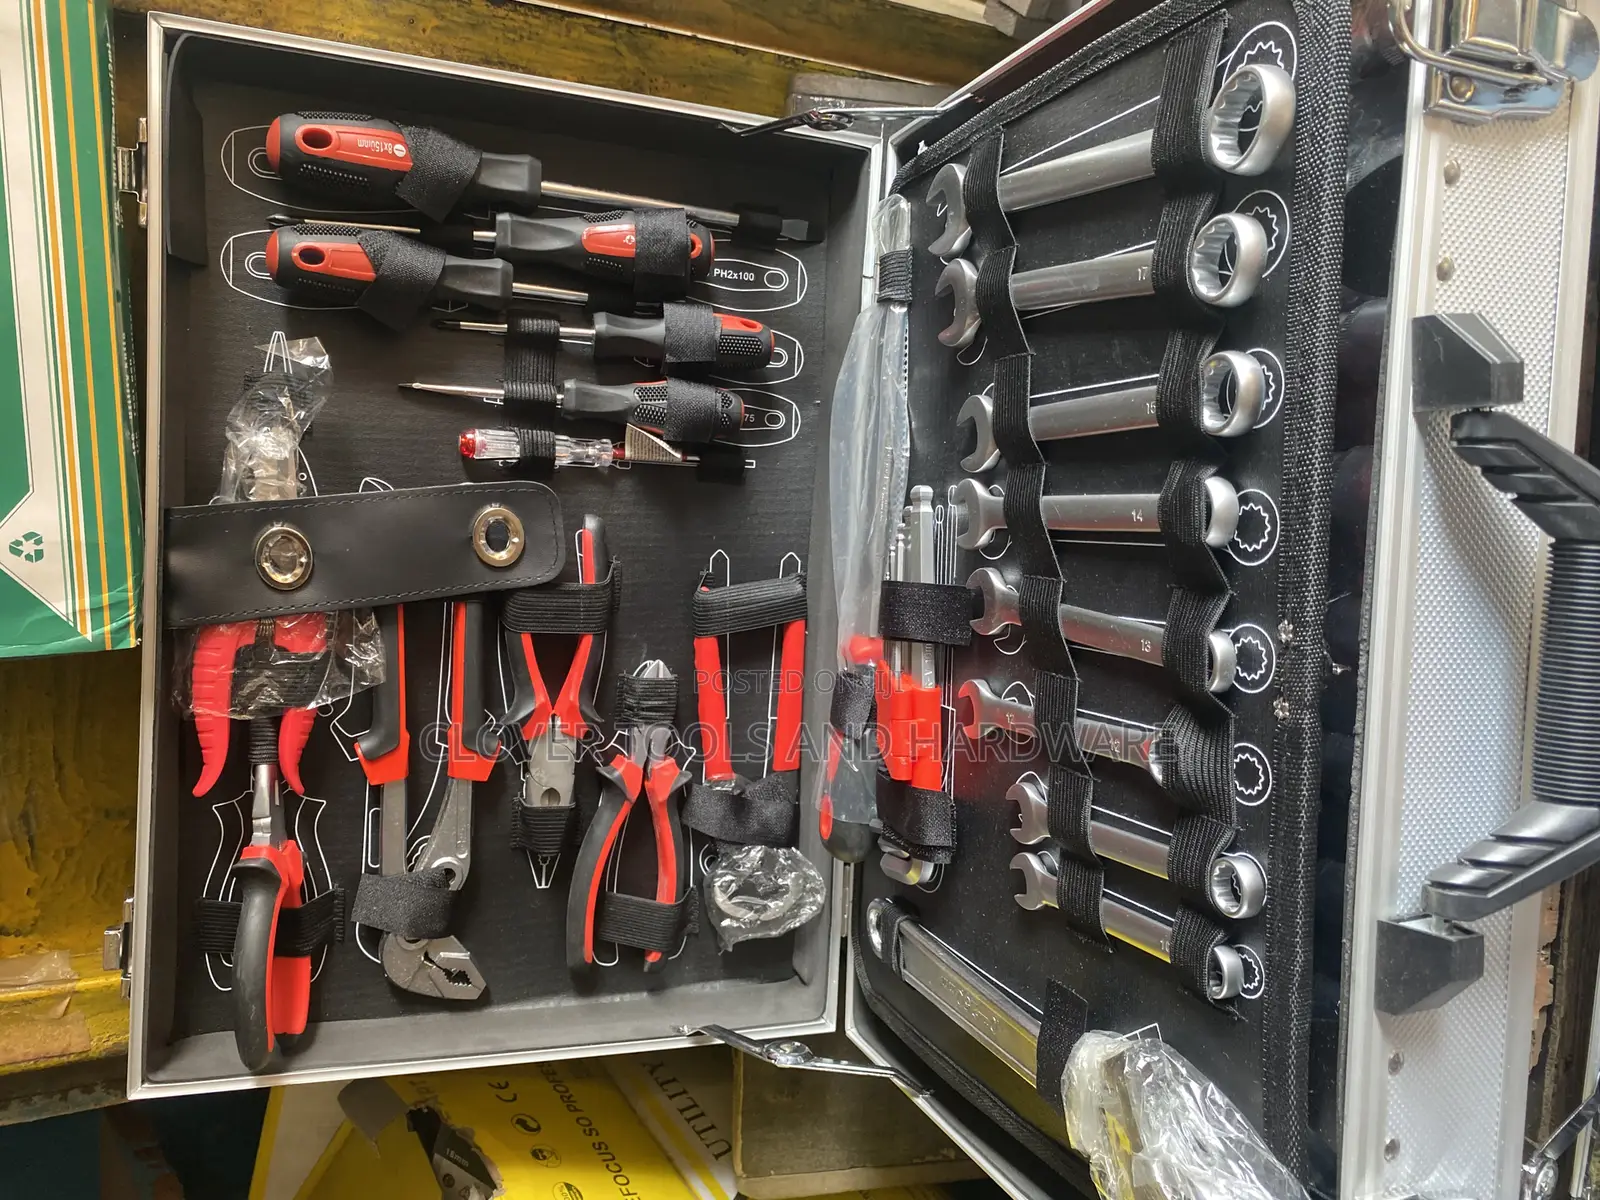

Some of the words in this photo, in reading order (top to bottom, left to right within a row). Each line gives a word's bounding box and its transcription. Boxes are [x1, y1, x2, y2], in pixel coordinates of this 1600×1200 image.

[714, 268, 755, 281] PH2x100
[1138, 266, 1148, 281] 17
[1132, 508, 1143, 522] 14
[1006, 714, 1015, 725] 12
[640, 1061, 733, 1162] UTILITY
[576, 1116, 600, 1137] SO
[591, 1141, 641, 1200] FOCUS
